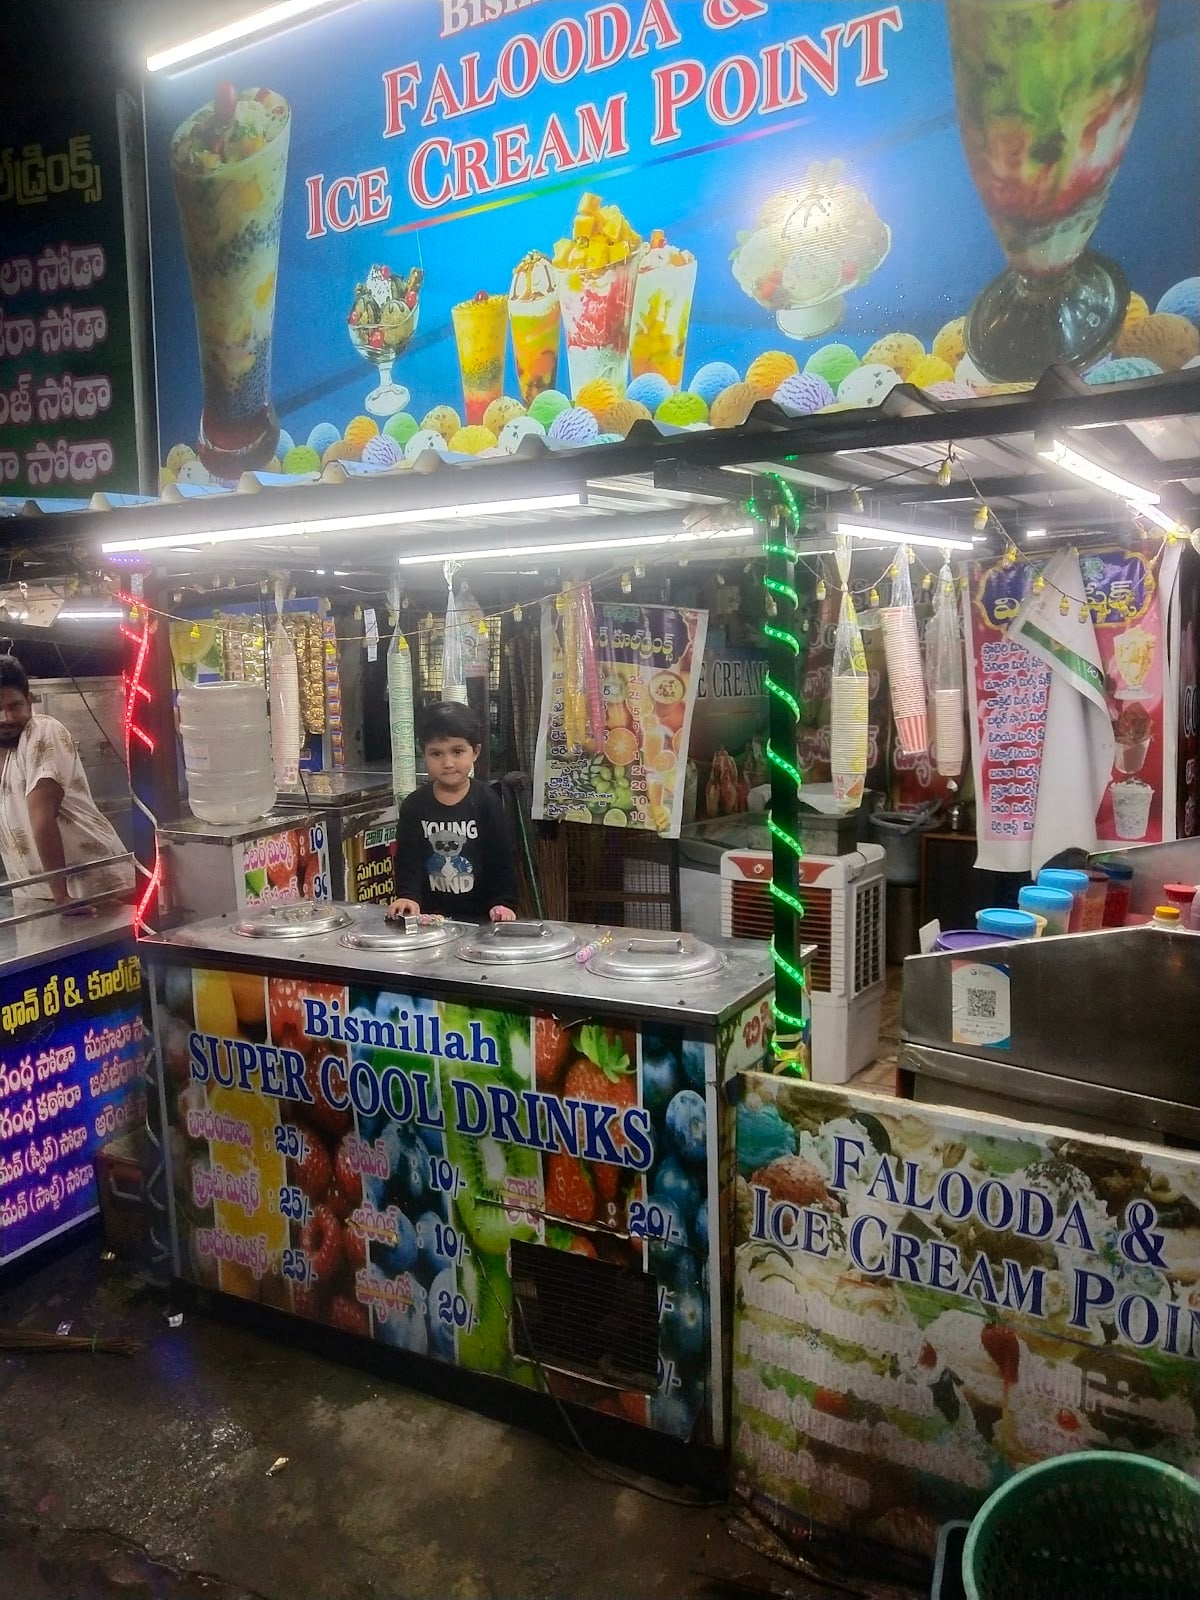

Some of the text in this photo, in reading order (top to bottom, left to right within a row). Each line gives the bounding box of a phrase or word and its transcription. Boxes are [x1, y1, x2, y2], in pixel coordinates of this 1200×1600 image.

[382, 0, 682, 138] FALOODA
[305, 4, 903, 239] ICE CREAM POINT
[631, 781, 647, 791] 20
[631, 796, 647, 806] 10
[421, 820, 478, 839] YOUNG
[630, 811, 646, 821] 10
[428, 874, 475, 894] KIND
[64, 976, 84, 1008] &
[303, 998, 500, 1066] Bismillah
[188, 1031, 652, 1170] SUPER COOL DRINKS
[273, 1125, 310, 1165] 25/-
[429, 1156, 467, 1199] 10/-
[278, 1186, 313, 1225] 25/-
[831, 1134, 1169, 1269] FALOODA &
[434, 1222, 471, 1268] 10/-
[628, 1201, 682, 1251] 20/-
[281, 1248, 318, 1289] 25/-
[752, 1185, 833, 1258] ICE
[849, 1214, 1046, 1318] CREAM
[438, 1289, 479, 1335] 20/-
